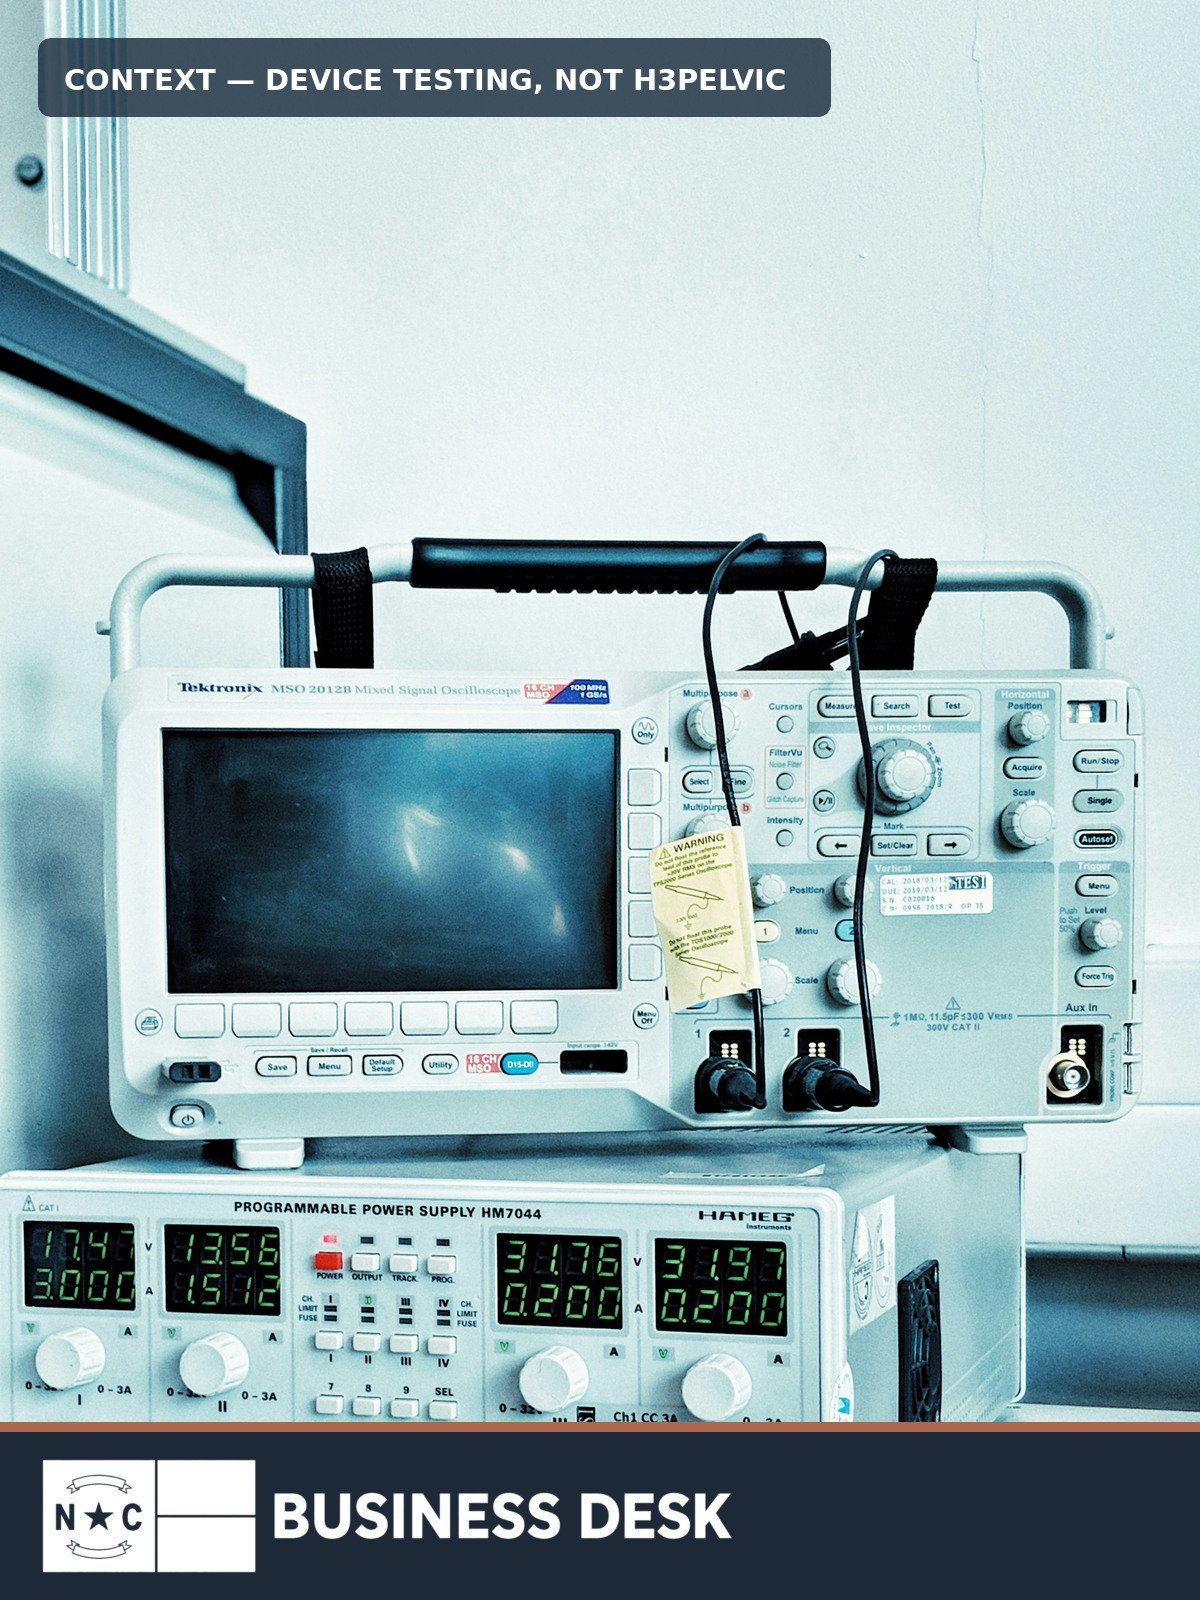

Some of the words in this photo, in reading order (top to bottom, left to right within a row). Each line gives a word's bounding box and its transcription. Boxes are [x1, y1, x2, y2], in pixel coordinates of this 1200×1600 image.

[177, 682, 263, 693] Tektronix
[271, 685, 305, 694] MSO
[308, 685, 352, 694] 2012B
[354, 685, 395, 695] Mixed
[398, 685, 438, 697] Signal
[441, 685, 521, 697] Oscilloscope
[1001, 690, 1050, 699] Horizontal
[769, 703, 803, 711] Cursors
[884, 702, 910, 710] Search
[944, 702, 961, 710] Test
[1008, 702, 1043, 711] Position
[886, 723, 932, 734] Inspector
[638, 730, 654, 740] Only
[1012, 764, 1042, 772] Acquire
[690, 778, 710, 786] Select
[1012, 788, 1036, 796] Scale
[1088, 796, 1112, 804] Single
[767, 816, 804, 825] Intensity
[884, 822, 904, 830] Mark
[673, 833, 724, 852] WARNING
[1082, 834, 1114, 843] Autoset
[877, 841, 914, 849] Set/Clear
[874, 864, 912, 872] Vertical
[1078, 862, 1112, 872] Trigger
[790, 886, 825, 894] Position
[1088, 882, 1110, 890] Menu
[795, 976, 818, 984] Scale
[1102, 972, 1114, 981] Trig
[1066, 1003, 1085, 1012] Aux
[1088, 1003, 1098, 1012] In
[927, 1024, 948, 1032] 300V
[784, 1028, 790, 1037] 2
[468, 1055, 480, 1064] 16
[482, 1055, 497, 1064] CH
[318, 1062, 341, 1070] Menu
[429, 1061, 452, 1070] Utility
[468, 1064, 491, 1072] MSO
[39, 1204, 54, 1212] CAT
[234, 1202, 357, 1215] PROGRAMMABLE
[362, 1204, 414, 1216] POWER
[420, 1206, 475, 1218] SUPPLY
[482, 1207, 542, 1220] HM7044
[699, 1210, 794, 1222] HAMEG
[634, 1258, 642, 1266] V
[146, 1286, 153, 1295] A
[401, 1298, 410, 1306] III
[438, 1299, 449, 1307] IV
[298, 1304, 318, 1312] LIMIT
[634, 1304, 643, 1313] A
[299, 1314, 318, 1322] FUSE
[457, 1310, 478, 1318] LIMIT
[124, 1328, 132, 1336] A
[268, 1333, 277, 1342] A
[609, 1346, 618, 1356] A
[364, 1356, 372, 1364] II
[401, 1357, 412, 1366] III
[438, 1358, 450, 1368] IV
[774, 1354, 783, 1364] A
[116, 1386, 132, 1394] 3A
[366, 1384, 372, 1392] 8
[403, 1386, 410, 1394] 9
[435, 1388, 454, 1396] SEL
[262, 1392, 277, 1400] 3A
[218, 1400, 227, 1412] II
[500, 1404, 506, 1412] 0
[614, 1412, 637, 1422] Ch1
[641, 1412, 658, 1422] CC
[662, 1414, 678, 1422] 3A
